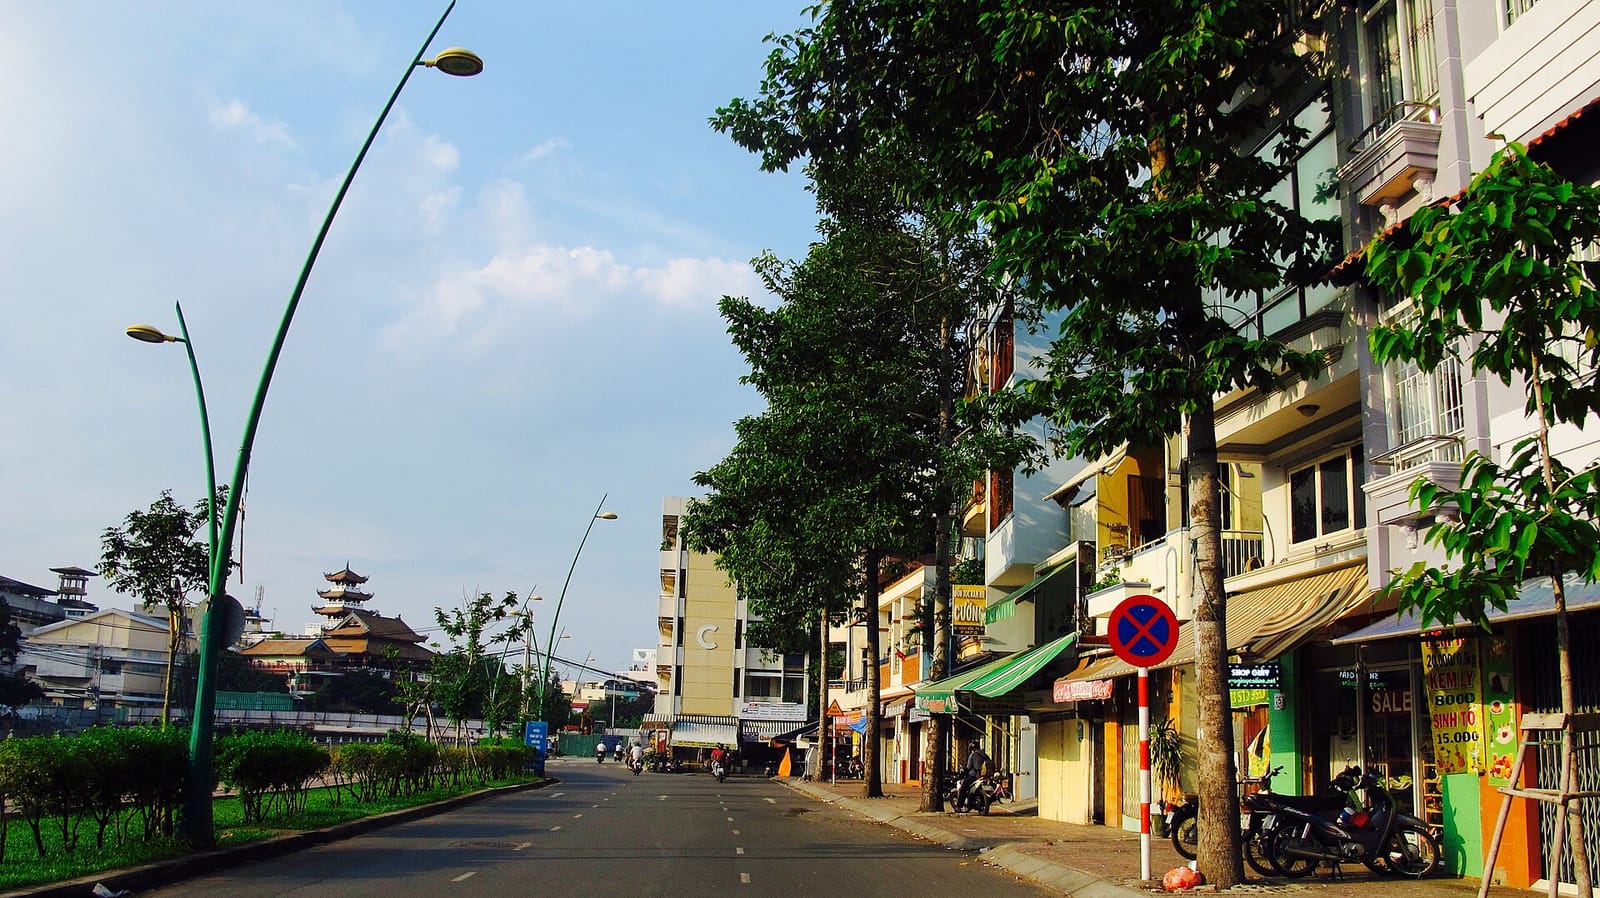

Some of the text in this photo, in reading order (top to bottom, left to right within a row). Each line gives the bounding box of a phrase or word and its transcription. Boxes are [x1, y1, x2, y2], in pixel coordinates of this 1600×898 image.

[696, 623, 719, 650] C
[1429, 671, 1457, 689] KEM
[1372, 691, 1412, 712] SALE
[1434, 692, 1475, 706] 8000
[1433, 712, 1457, 728] SINH
[1436, 730, 1479, 744] 15.000
